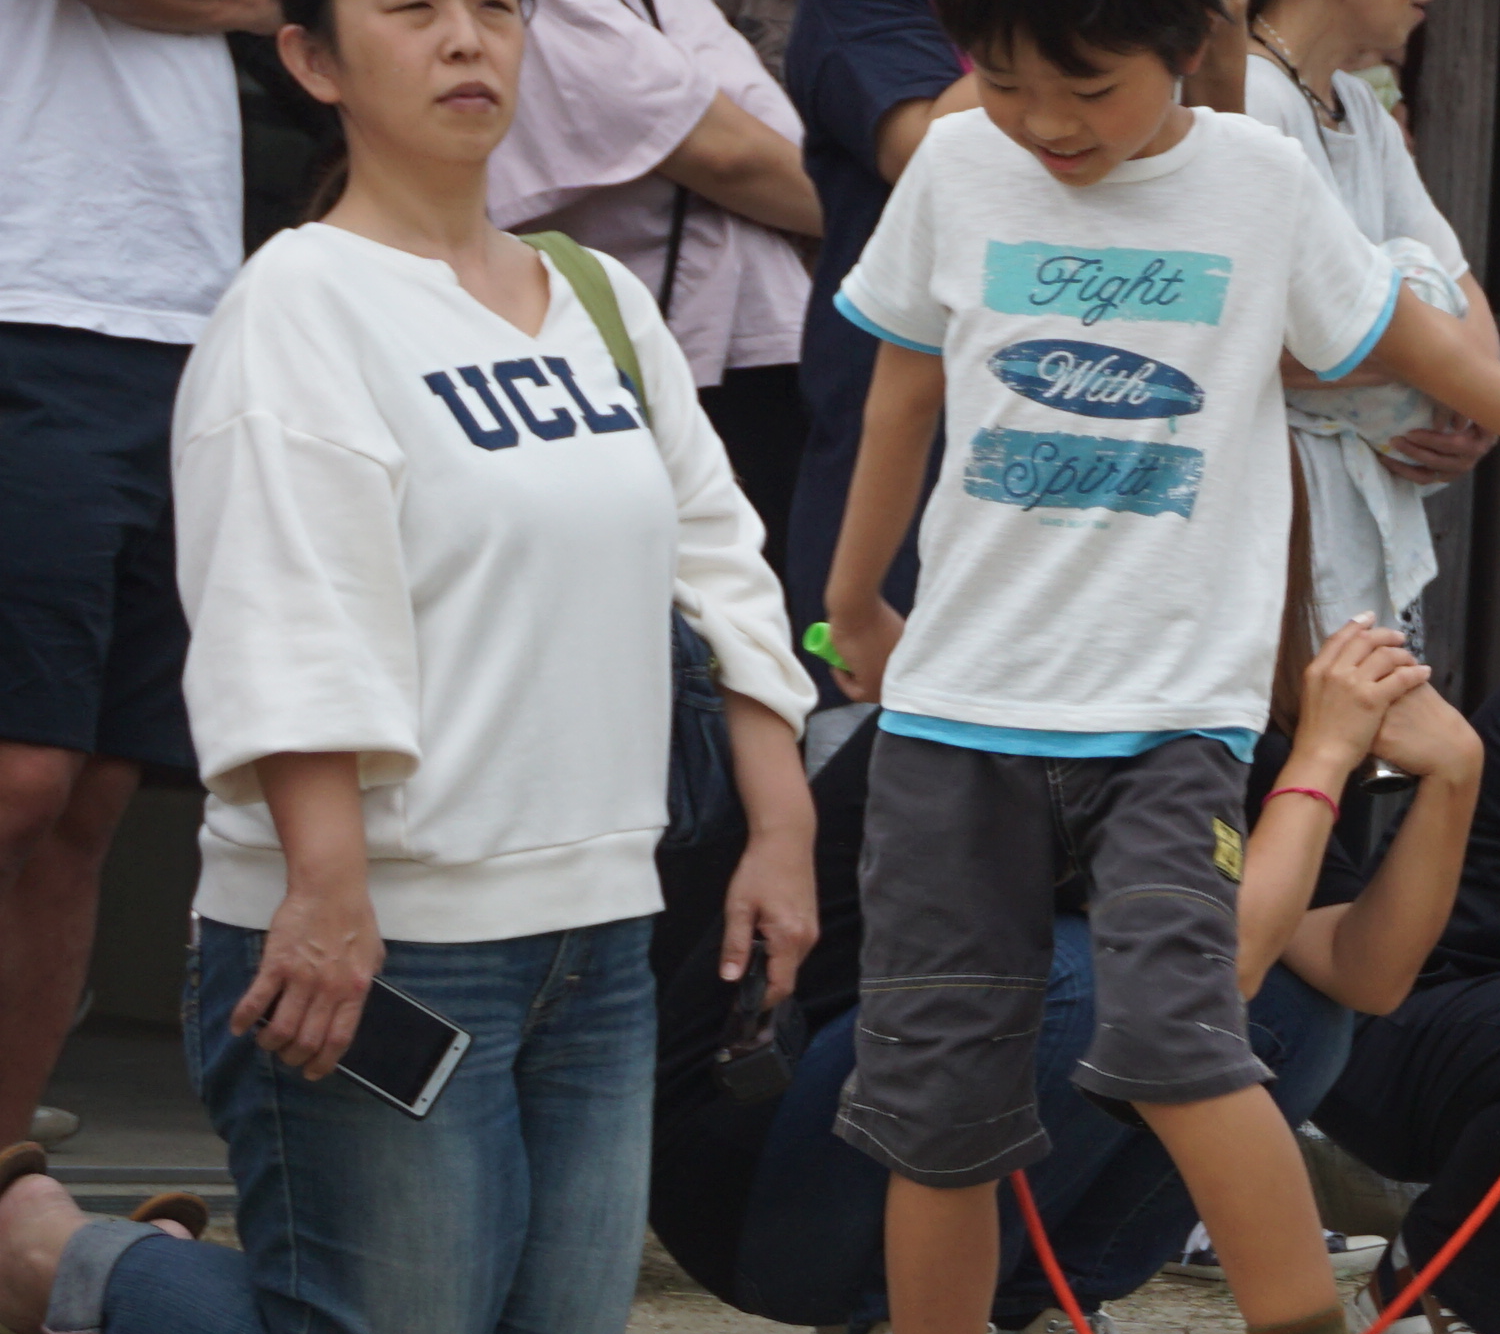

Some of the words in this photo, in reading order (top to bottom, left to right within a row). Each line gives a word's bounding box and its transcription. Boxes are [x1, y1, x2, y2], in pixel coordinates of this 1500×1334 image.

[1028, 255, 1186, 327] Fight
[1036, 349, 1156, 406] With
[1002, 441, 1161, 512] Spirit
